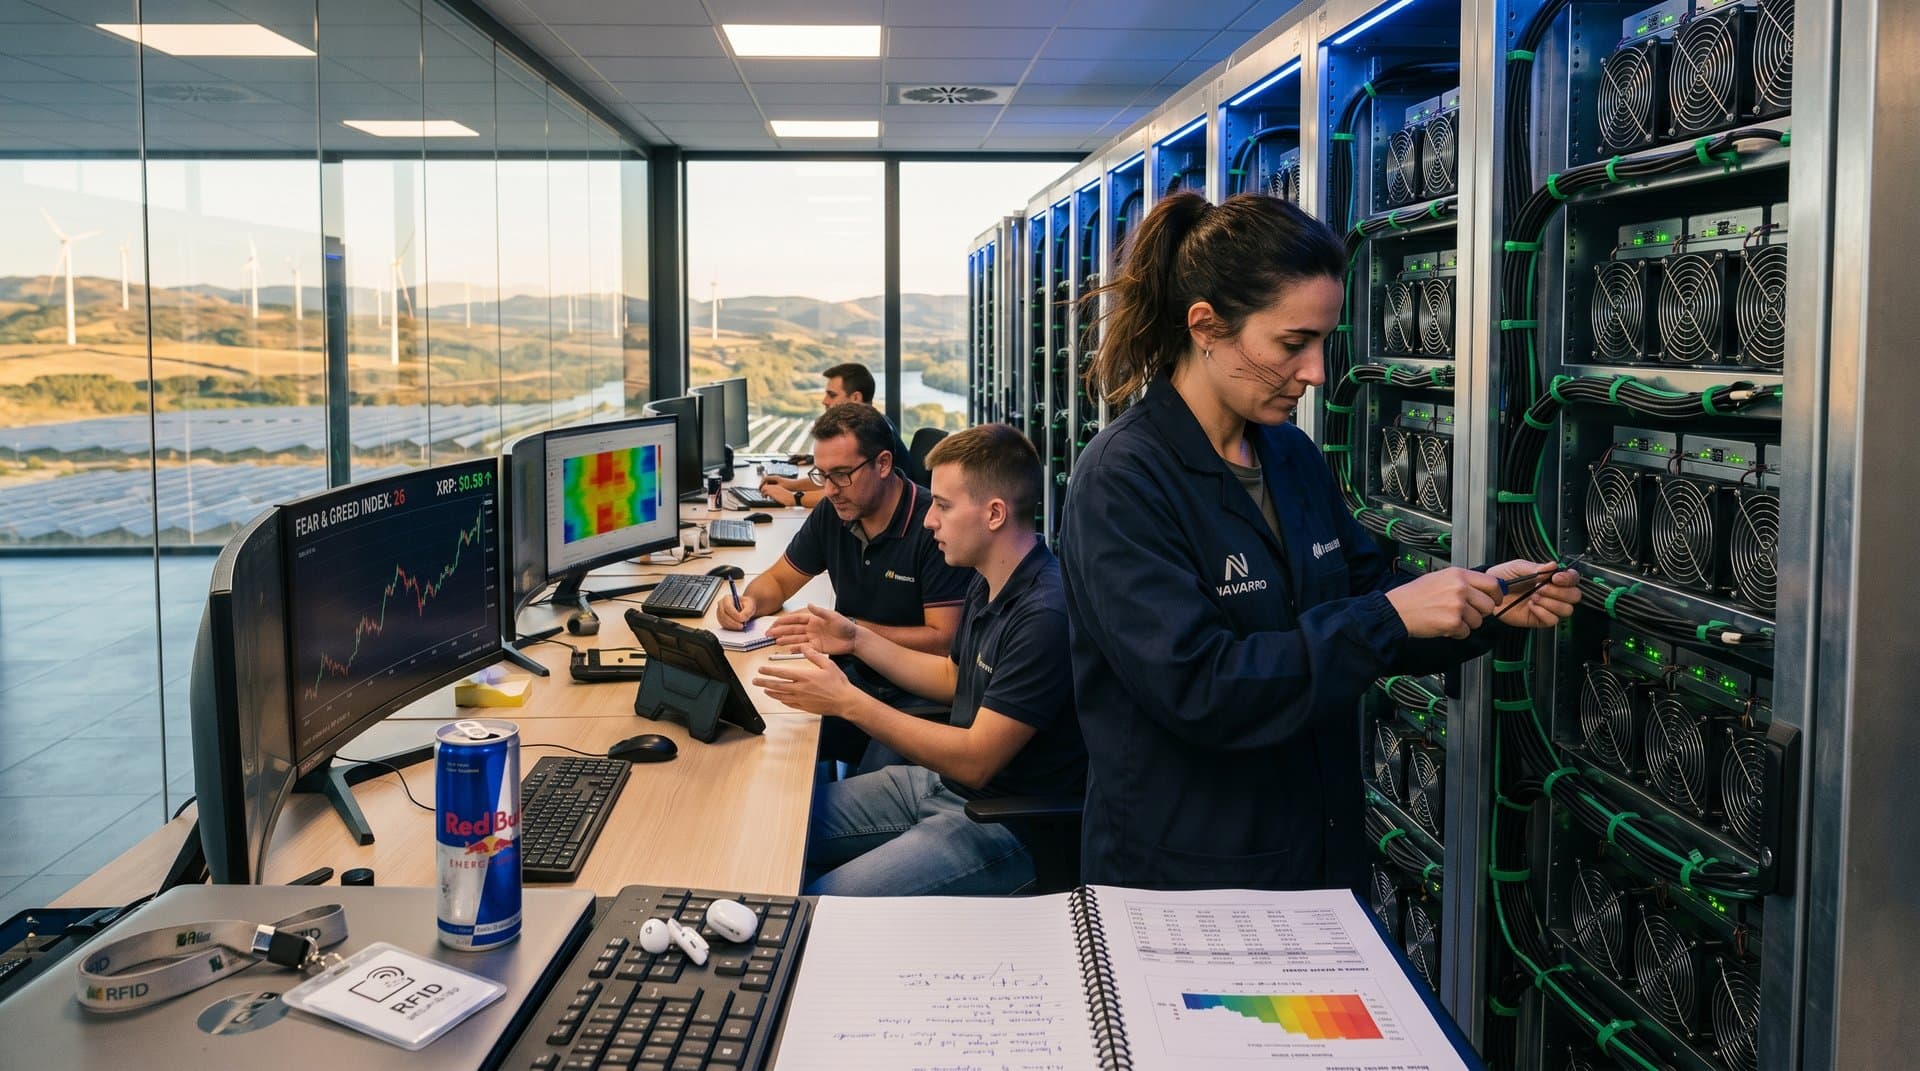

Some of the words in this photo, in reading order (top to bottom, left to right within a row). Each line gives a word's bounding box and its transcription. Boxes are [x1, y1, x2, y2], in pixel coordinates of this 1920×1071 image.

[436, 478, 457, 496] XRP:
[458, 472, 483, 493] $0.58
[296, 511, 319, 537] FEAR
[321, 511, 328, 528] &
[329, 504, 360, 526] GREED
[361, 493, 392, 516] INDEX:
[393, 489, 406, 507] 26
[445, 811, 490, 837] Red
[494, 806, 520, 833] Bul
[106, 982, 149, 1001] RFID
[390, 983, 443, 1014] RFID
